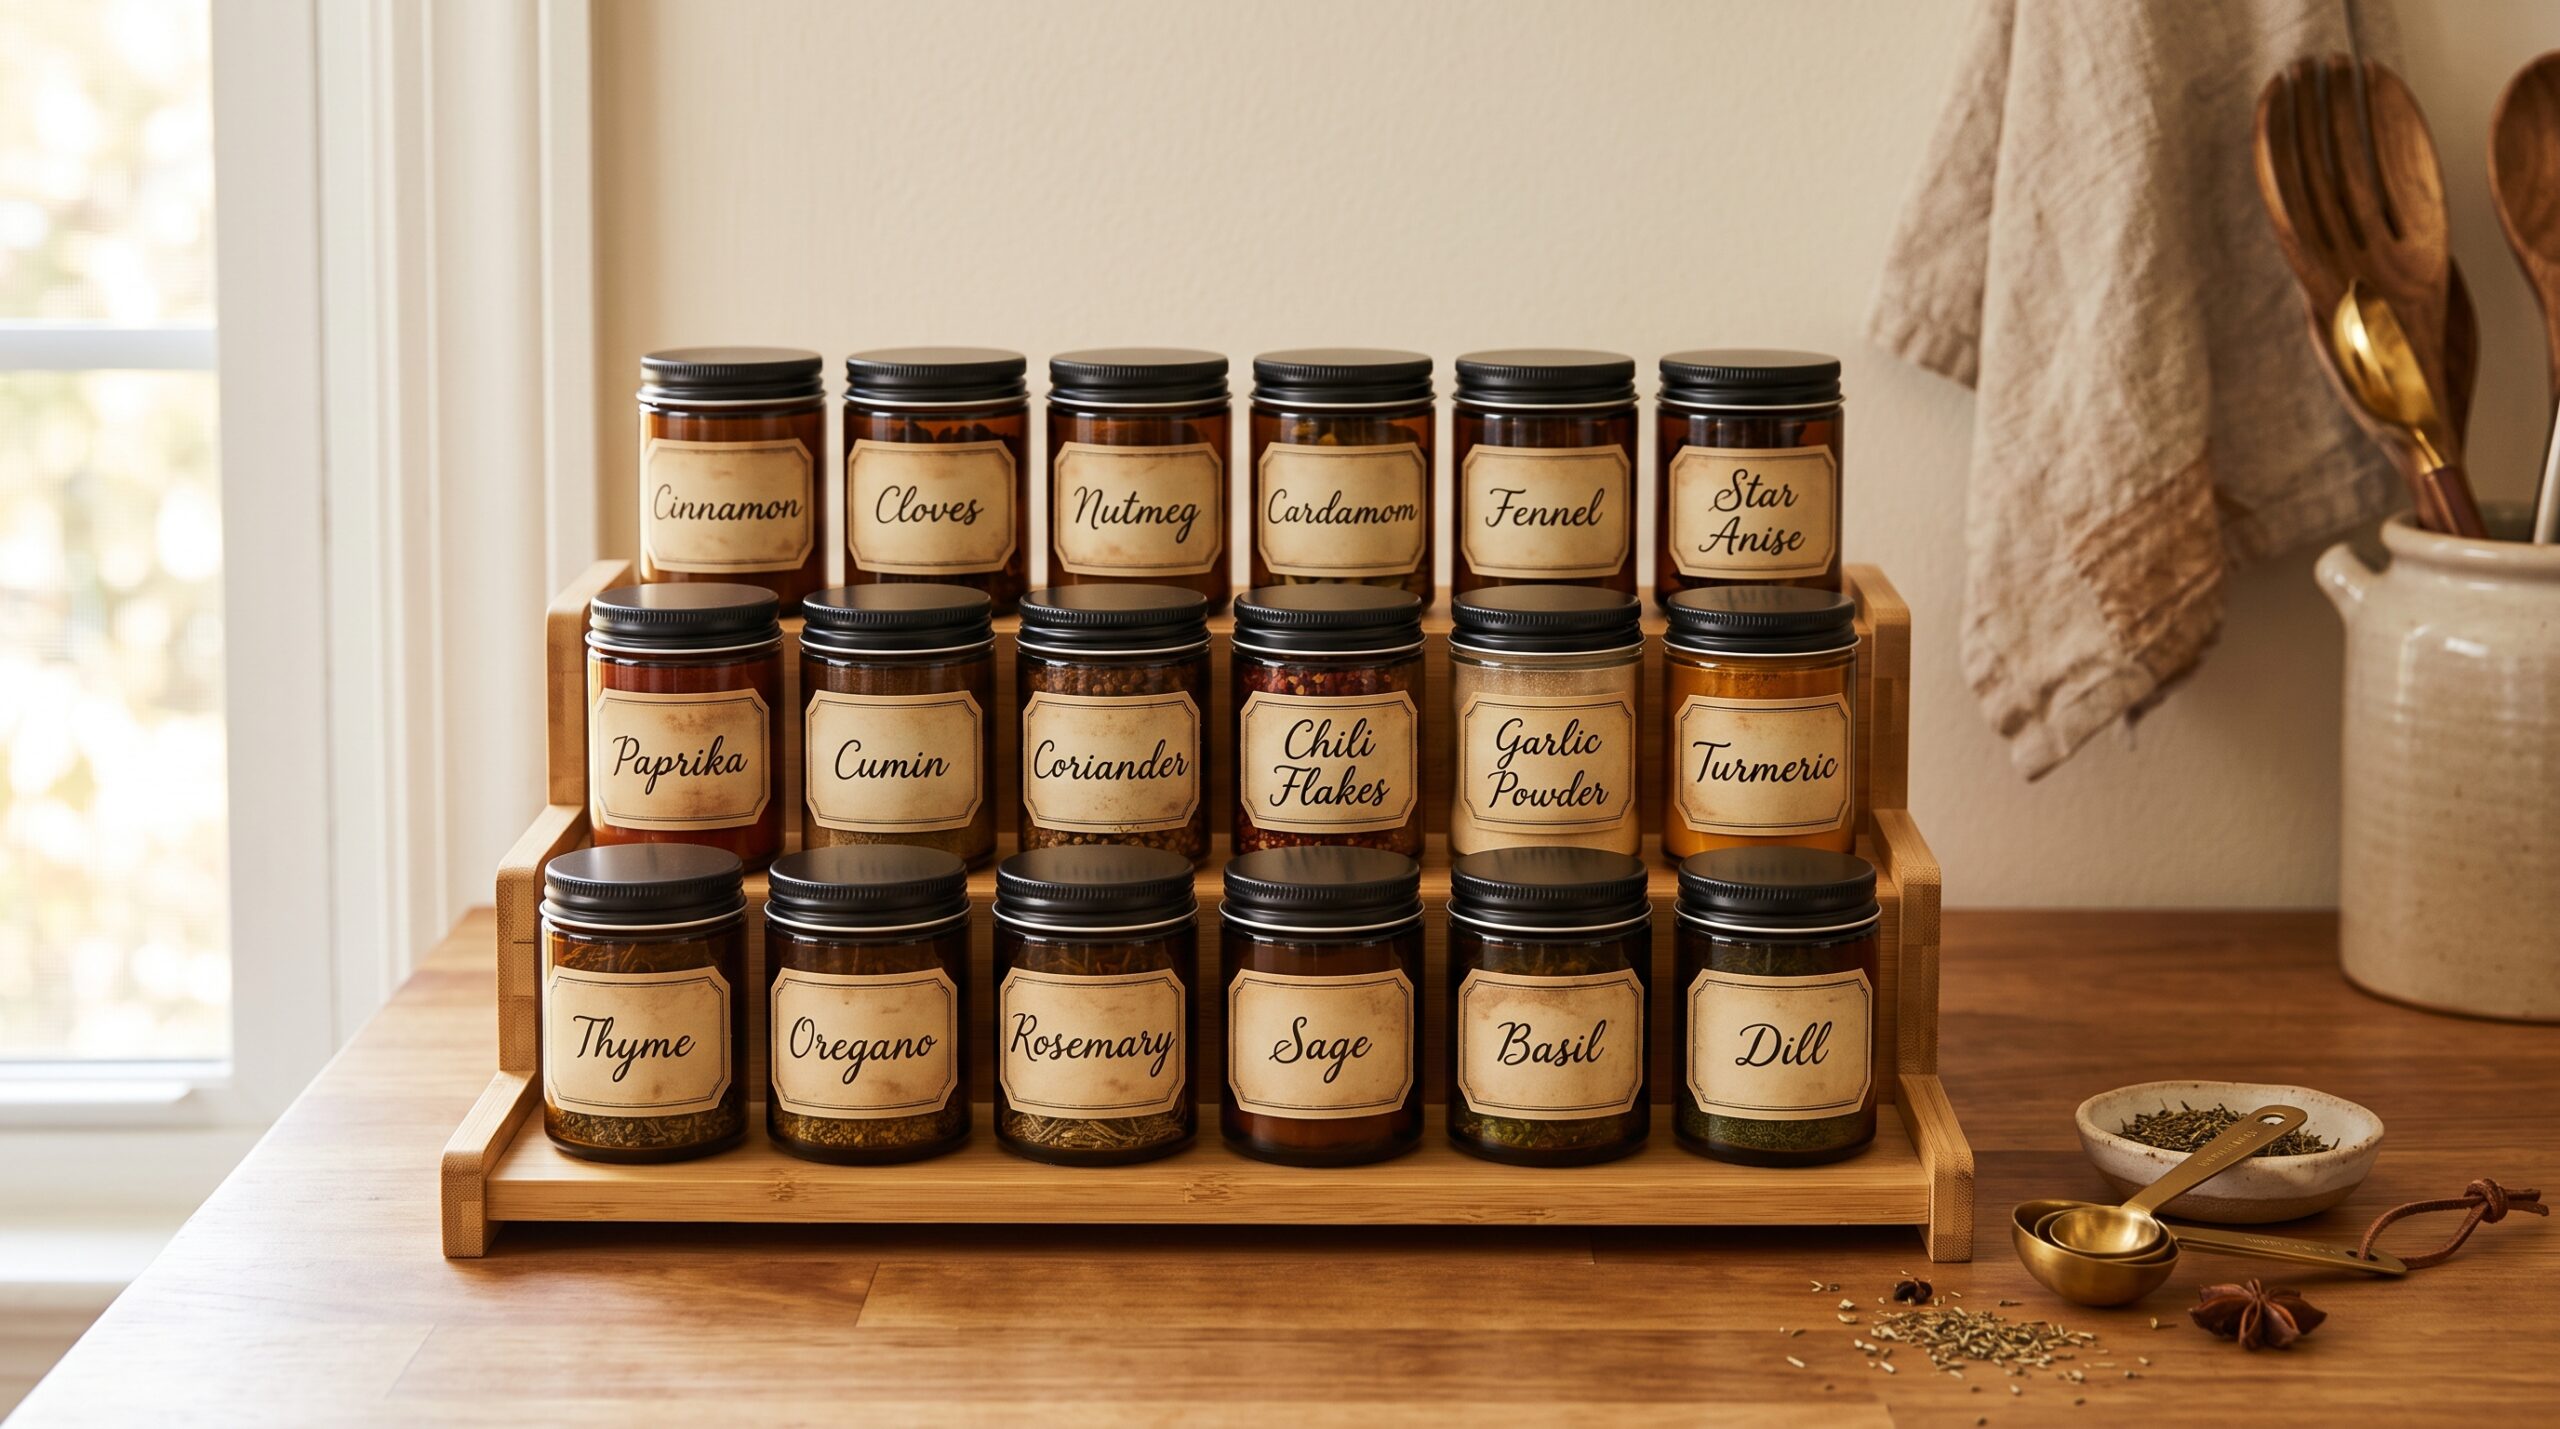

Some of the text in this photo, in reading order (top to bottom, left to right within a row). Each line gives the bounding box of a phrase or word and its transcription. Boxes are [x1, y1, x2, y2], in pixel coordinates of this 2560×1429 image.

[653, 484, 803, 522] Cinnamon
[875, 485, 985, 526] Cloves
[1266, 488, 1418, 525] Cardamom
[1485, 487, 1605, 527] Fennel
[1708, 468, 1799, 513] Star
[1073, 486, 1201, 544] Nutmeg
[1697, 514, 1807, 557] Anise
[833, 739, 951, 781] Cumin
[1032, 738, 1190, 782] Coriander
[1284, 717, 1377, 760] Chili
[1495, 717, 1602, 768] Garlic
[612, 734, 749, 796] Paprika
[1692, 740, 1840, 784] Turmeric
[1269, 764, 1391, 808] Flakes
[1487, 768, 1610, 809] Powder
[573, 1015, 697, 1084] Thyme
[788, 1016, 939, 1085] Oregano
[1011, 1012, 1176, 1079] Rosemary
[1268, 1016, 1373, 1084] Sage
[1497, 1018, 1606, 1067] Basil
[1735, 1020, 1833, 1067] Dill
